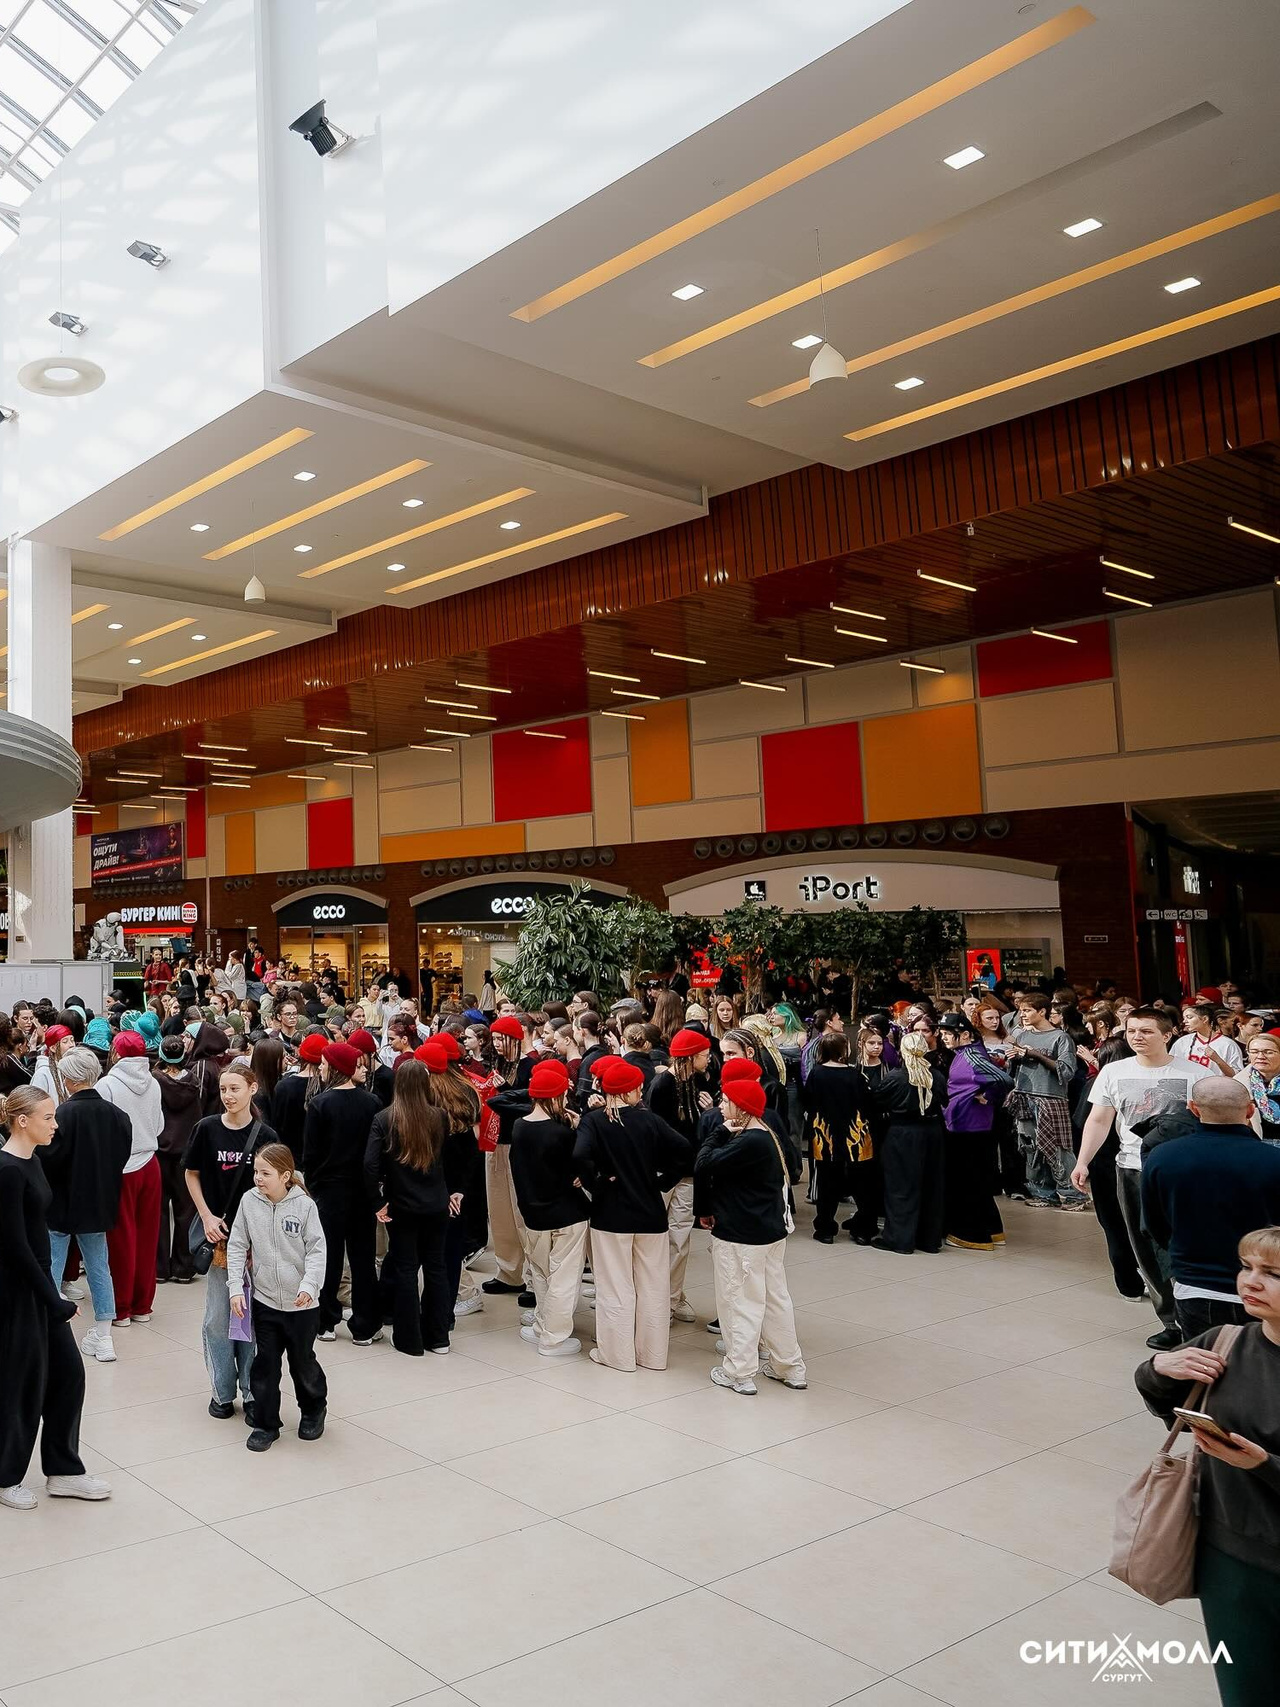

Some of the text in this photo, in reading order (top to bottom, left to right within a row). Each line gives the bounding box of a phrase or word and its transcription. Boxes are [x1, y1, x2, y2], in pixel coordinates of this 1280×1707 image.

[93, 843, 118, 857] ОЩУТИ
[93, 855, 120, 870] ДРАЙВ!
[799, 875, 879, 901] iPort
[313, 904, 346, 919] ecco
[490, 896, 536, 914] ecco
[121, 906, 156, 922] БУРГЕР
[285, 1220, 300, 1234] NY
